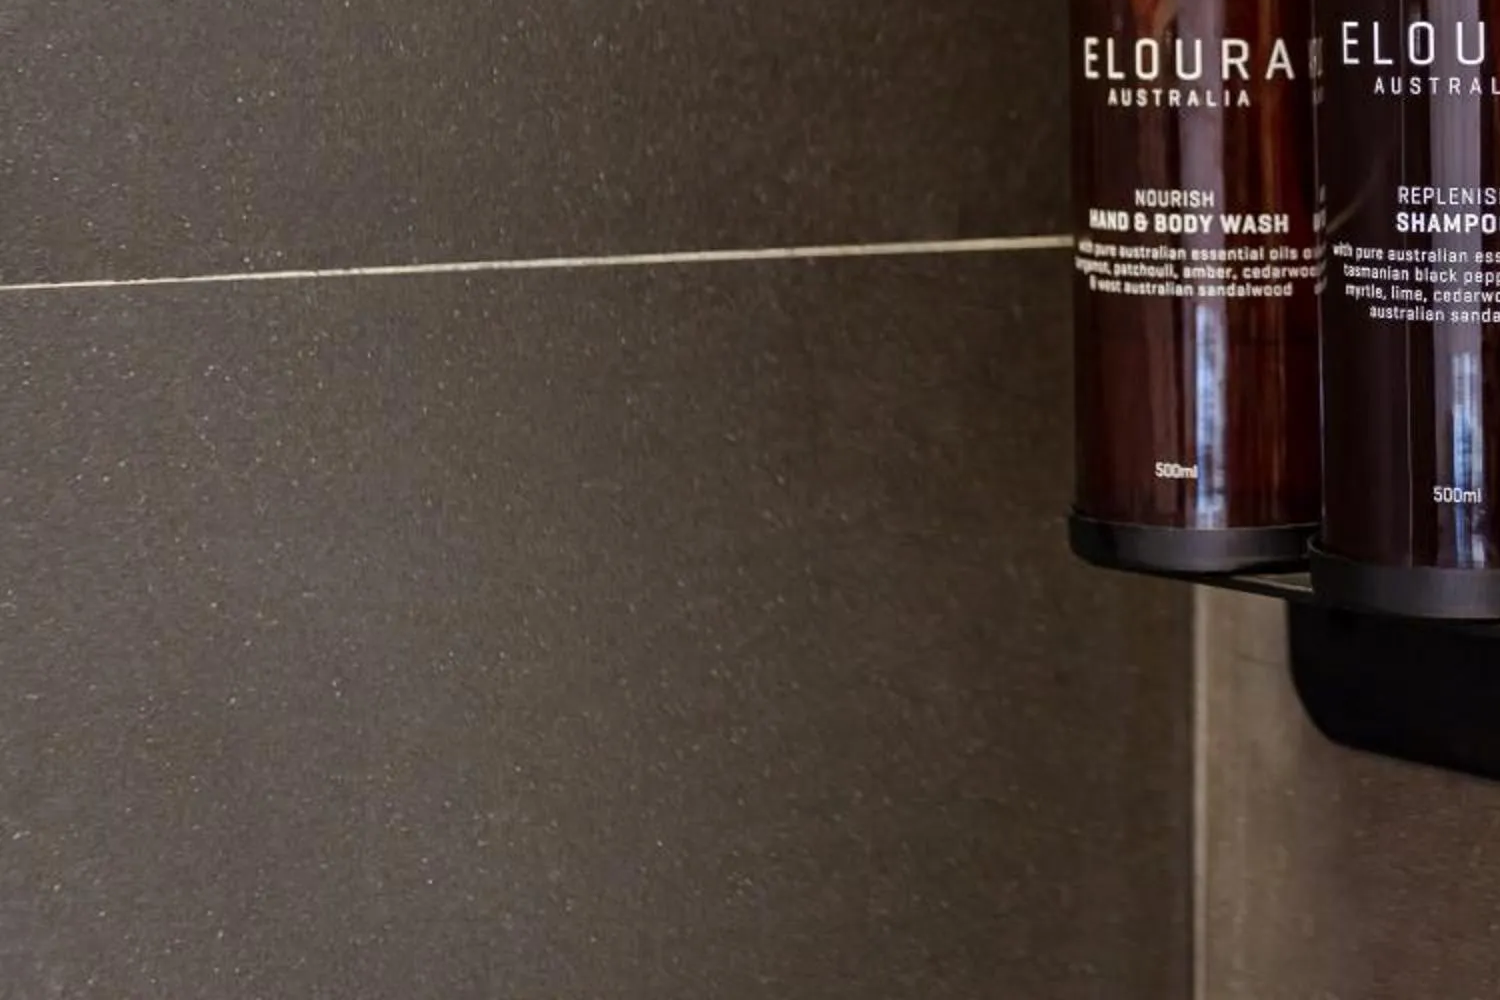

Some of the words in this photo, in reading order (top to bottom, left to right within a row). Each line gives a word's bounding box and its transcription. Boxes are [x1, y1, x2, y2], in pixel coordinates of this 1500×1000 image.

[1084, 36, 1295, 80] ELOURA
[1108, 88, 1251, 107] AUSTRALIA
[1135, 188, 1215, 208] NOURISH
[1089, 208, 1130, 232] HAND
[1134, 211, 1149, 233] &
[1154, 213, 1213, 234] BODY
[1220, 213, 1289, 234] WASH
[1119, 245, 1187, 260] australian
[1191, 246, 1264, 261] essential
[1269, 246, 1298, 260] oils
[1355, 247, 1384, 262] pure
[1387, 247, 1468, 263] australian
[1182, 264, 1238, 280] amber,
[1343, 263, 1410, 281] tasmanian
[1414, 266, 1458, 283] black
[1197, 282, 1293, 297] sandalwood
[1345, 283, 1387, 301] myrtle,
[1391, 285, 1428, 303] lime,
[1369, 305, 1445, 321] australian
[1155, 461, 1198, 479] 500ml
[1433, 486, 1482, 503] 500ml
